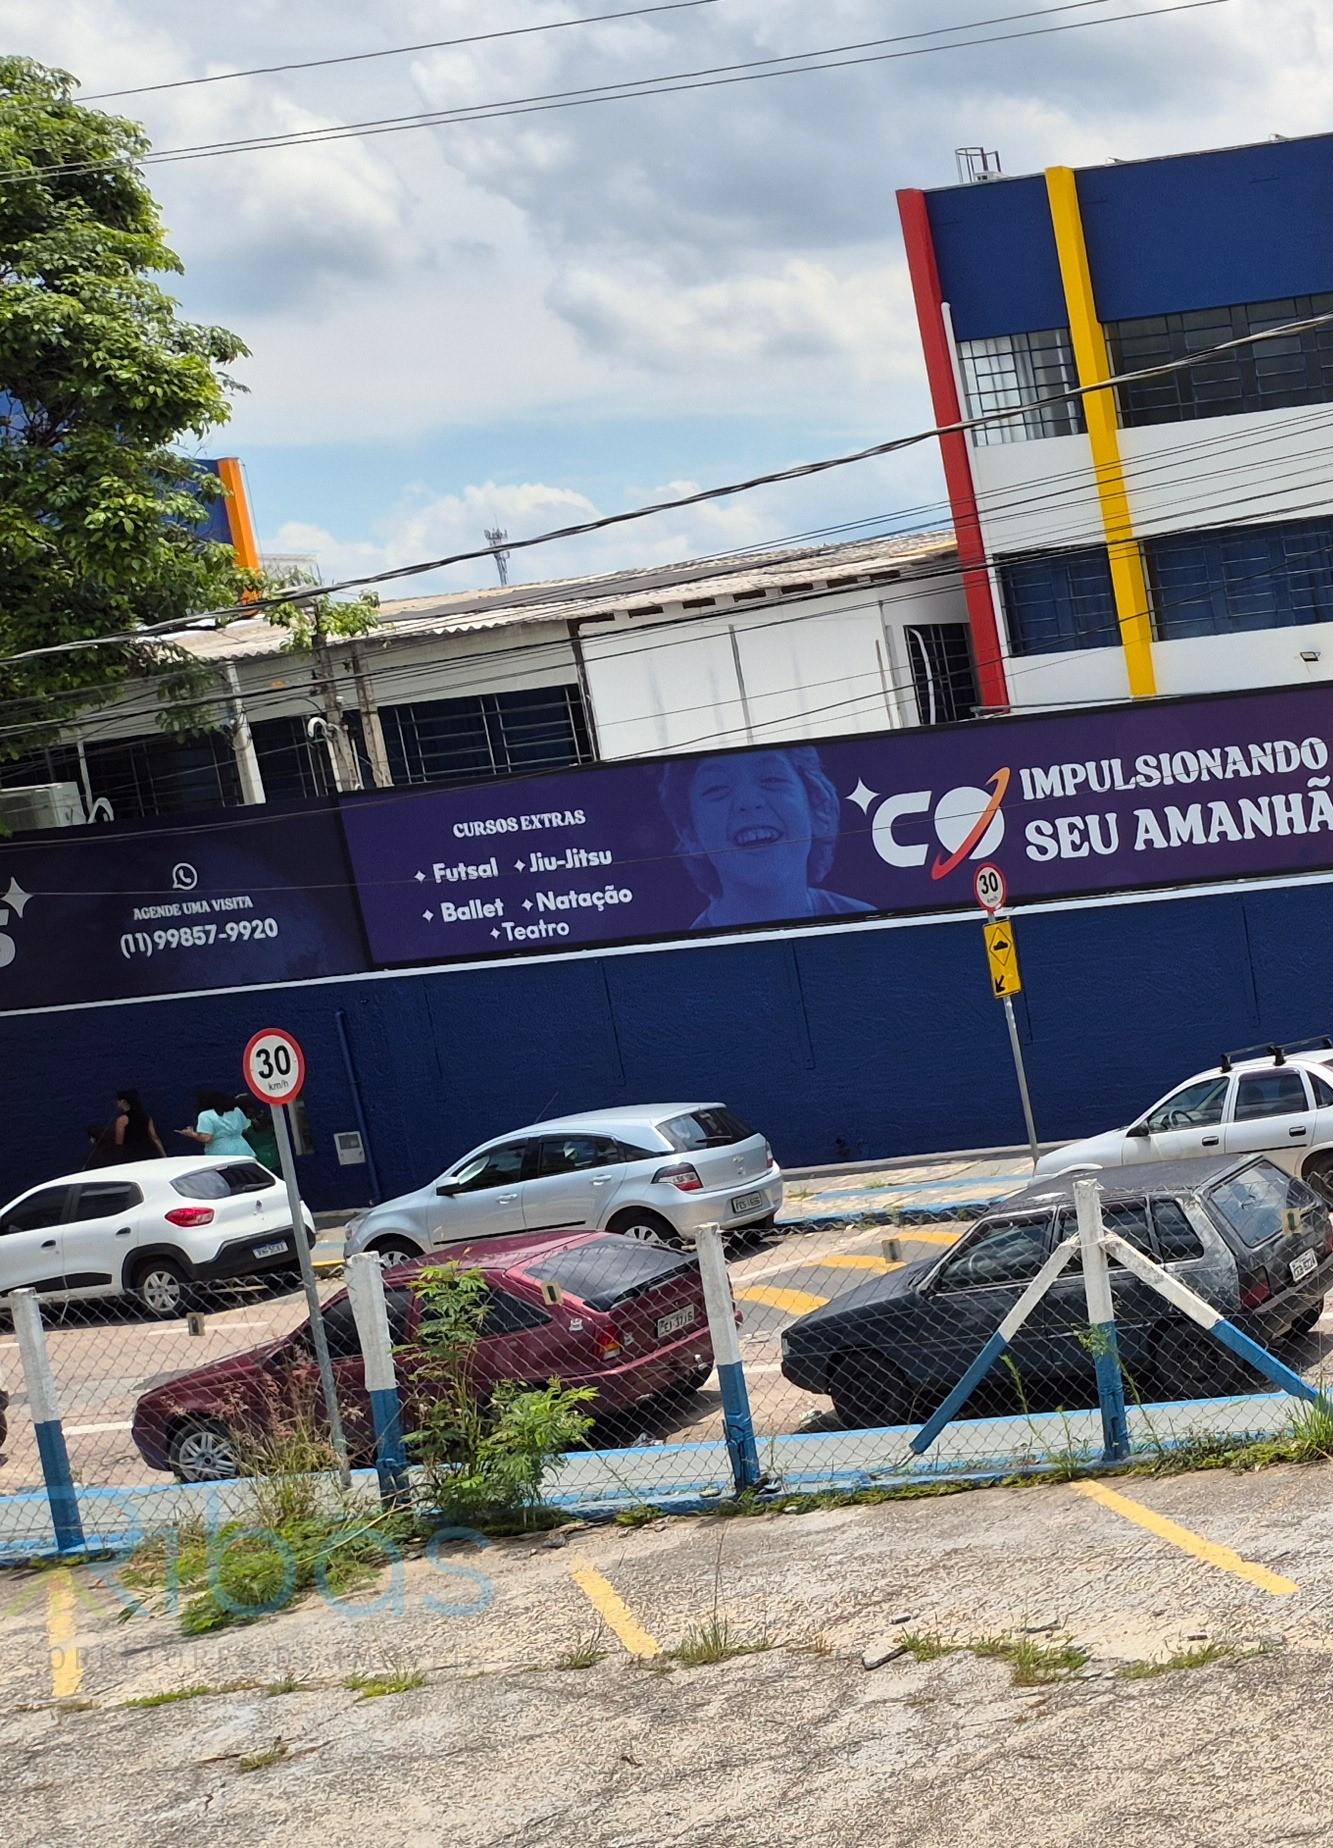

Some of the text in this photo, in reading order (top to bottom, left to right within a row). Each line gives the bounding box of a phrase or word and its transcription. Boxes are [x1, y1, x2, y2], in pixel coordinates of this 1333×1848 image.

[1020, 737, 1329, 800] IMPULSIONANDO
[452, 809, 586, 838] CURSOS EXTRAS
[872, 778, 1007, 870] CO
[1025, 812, 1120, 862] SEU
[432, 848, 613, 883] Futsal Jiu-Jitsu
[979, 871, 999, 895] 30
[133, 895, 253, 920] AGENDE UMA VISITA
[440, 884, 633, 923] Ballet Natação
[501, 919, 570, 941] Teatro
[255, 1045, 291, 1079] 30
[268, 1080, 289, 1091] km/h
